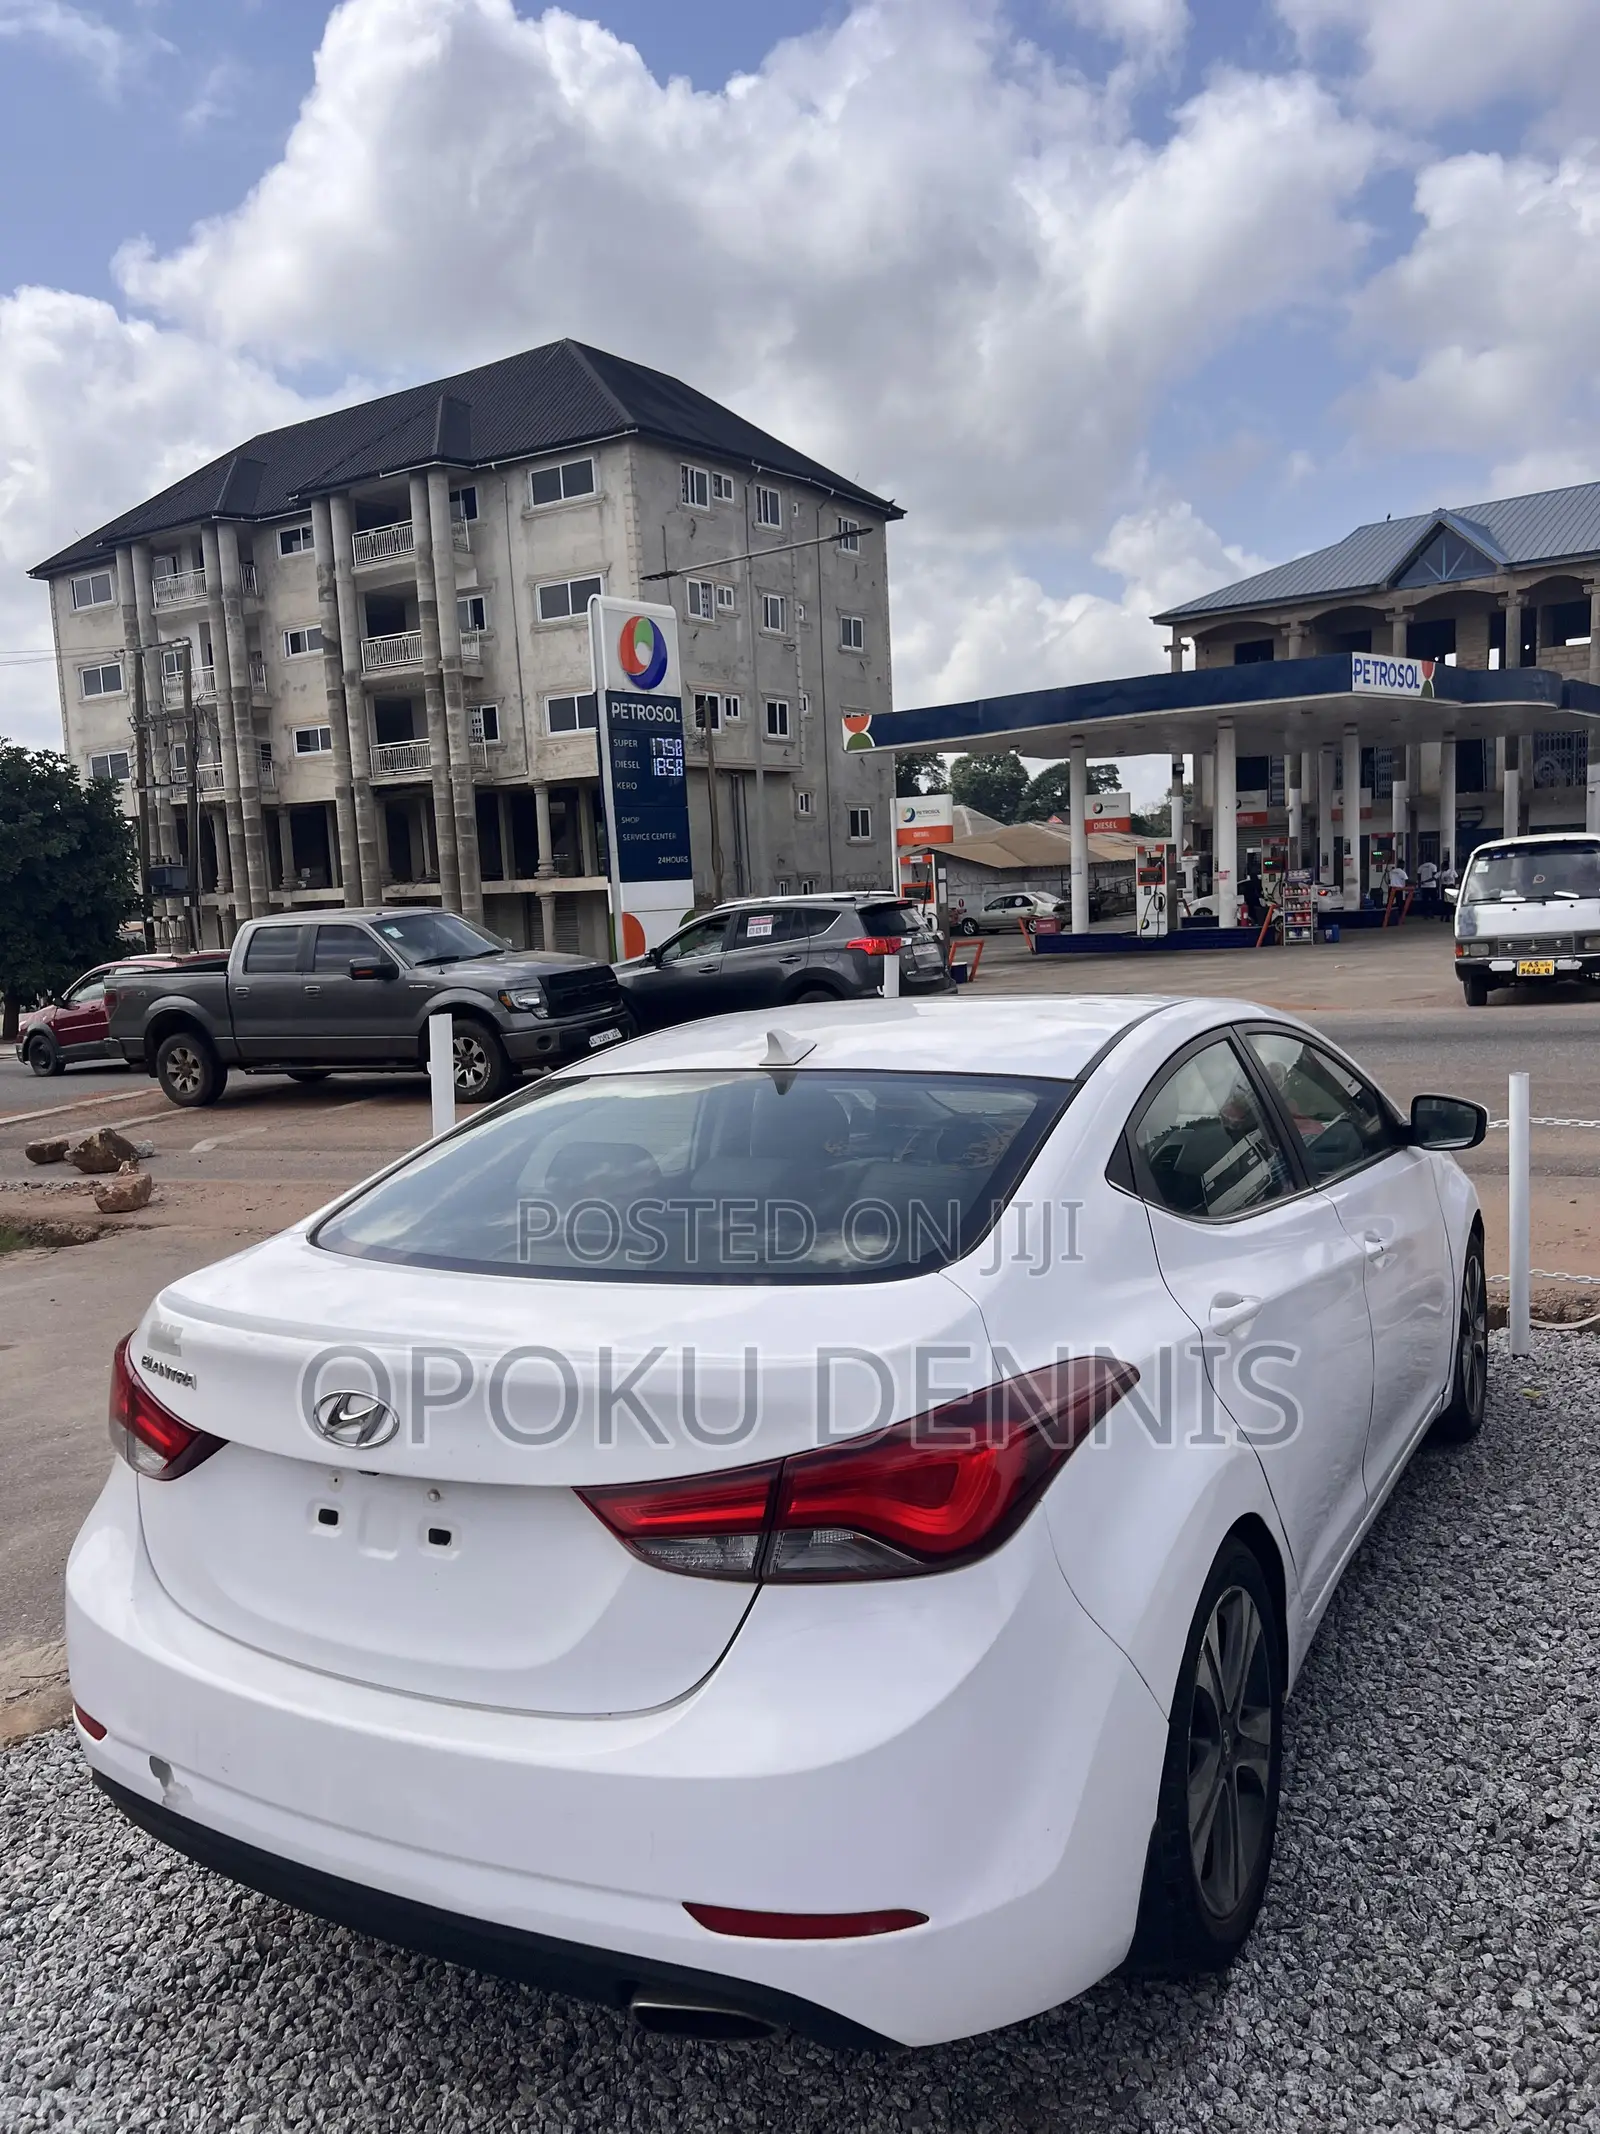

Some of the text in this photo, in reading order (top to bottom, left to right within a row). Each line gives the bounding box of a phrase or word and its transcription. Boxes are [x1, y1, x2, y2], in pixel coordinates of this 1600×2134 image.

[1353, 658, 1420, 689] PETROSOL
[611, 702, 681, 723] PETROSOL
[613, 739, 638, 748] SUPER
[615, 760, 641, 769] DIESEL
[616, 782, 638, 790] KERO
[621, 816, 640, 824] SHOP
[1093, 821, 1118, 830] DIESEL
[622, 832, 677, 841] SERVICE CENTER
[657, 855, 689, 865] 24HOURS
[141, 1354, 197, 1390] ELANTRA
